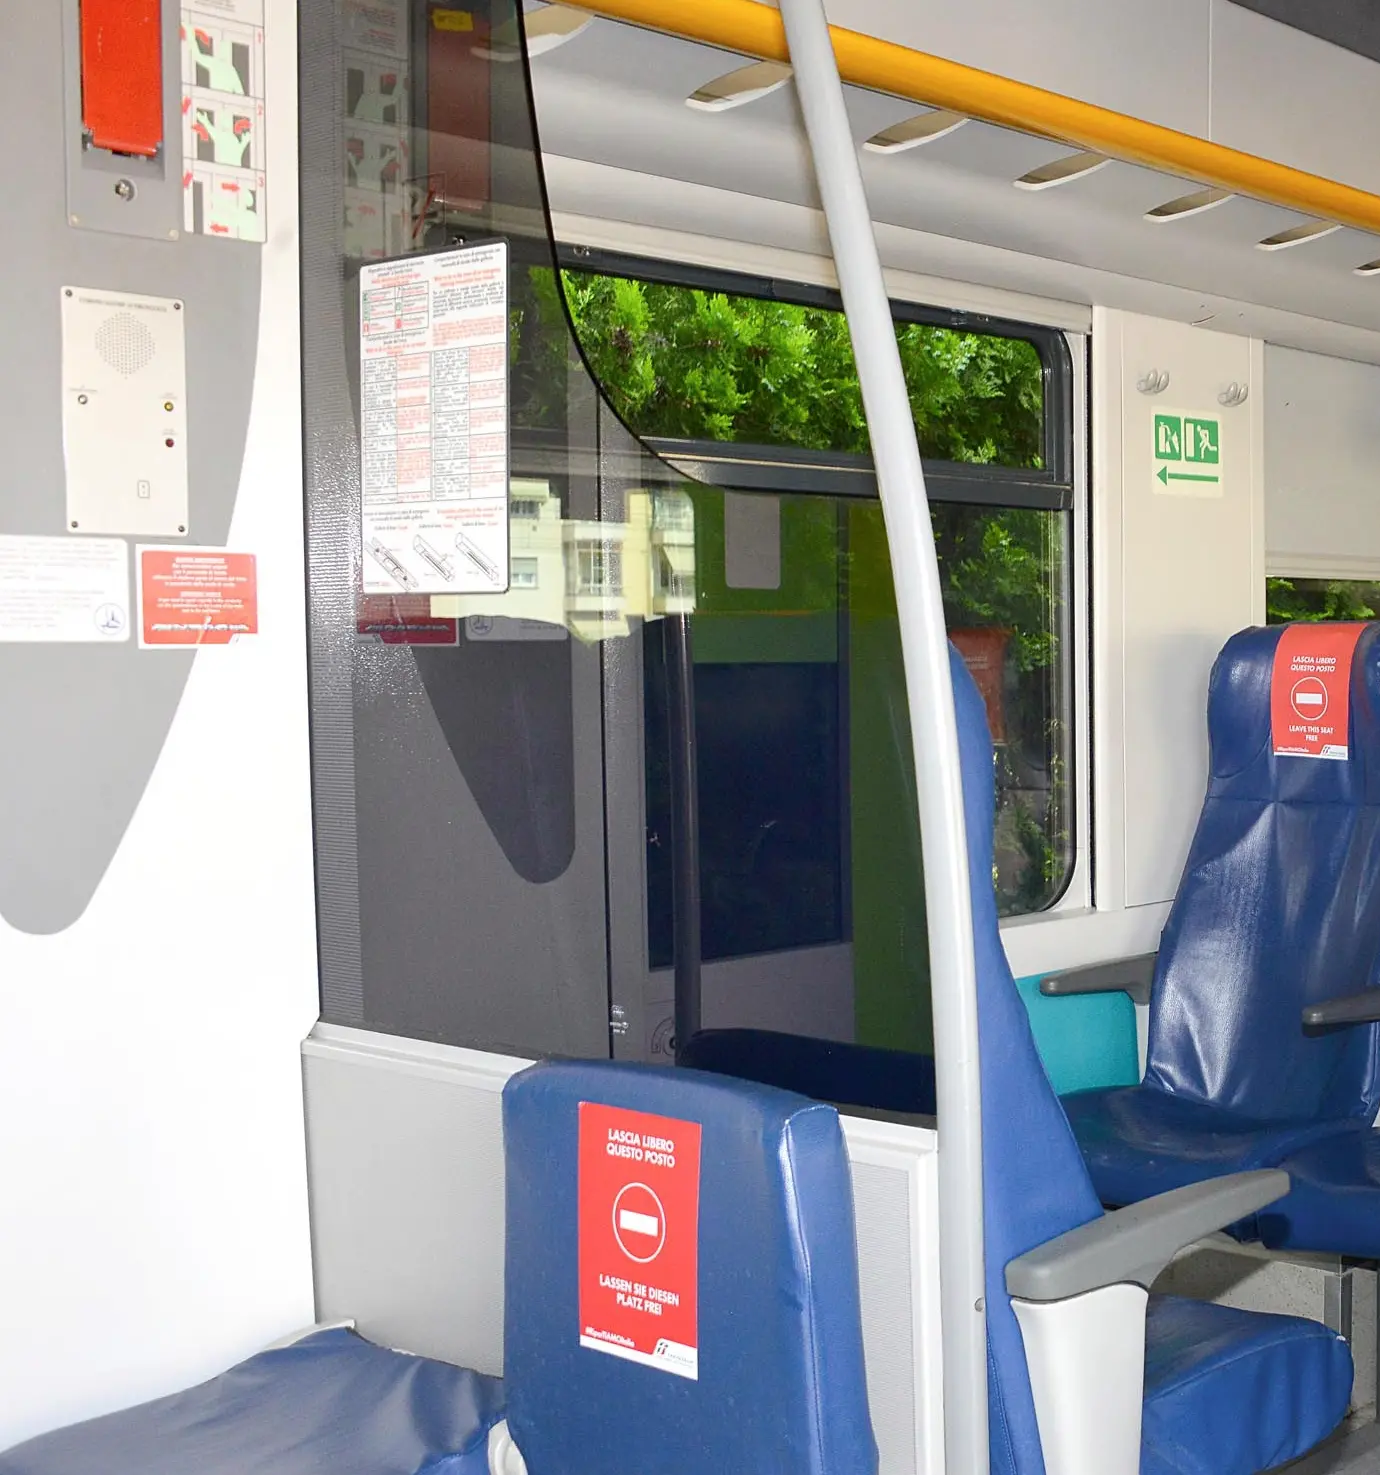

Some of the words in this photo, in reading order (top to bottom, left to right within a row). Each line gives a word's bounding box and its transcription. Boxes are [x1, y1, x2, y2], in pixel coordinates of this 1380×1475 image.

[1290, 664, 1315, 673] QUESTO
[1315, 665, 1336, 673] POSTO
[1292, 655, 1315, 664] LASCIA
[1315, 656, 1337, 665] LIBERO
[1289, 725, 1307, 733] LEAVE
[1307, 725, 1320, 734] THIS
[1320, 726, 1334, 734] SEAT
[1305, 734, 1319, 742] FREE
[608, 1128, 641, 1147] LASCIA
[642, 1135, 675, 1154] LIBERO
[606, 1142, 643, 1162] QUESTO
[644, 1149, 676, 1168] POSTO
[599, 1273, 634, 1296] LASSEN
[634, 1282, 648, 1298] SIE
[649, 1286, 680, 1307] DIESEN
[616, 1292, 644, 1312] PLATZ
[644, 1299, 663, 1316] FREI
